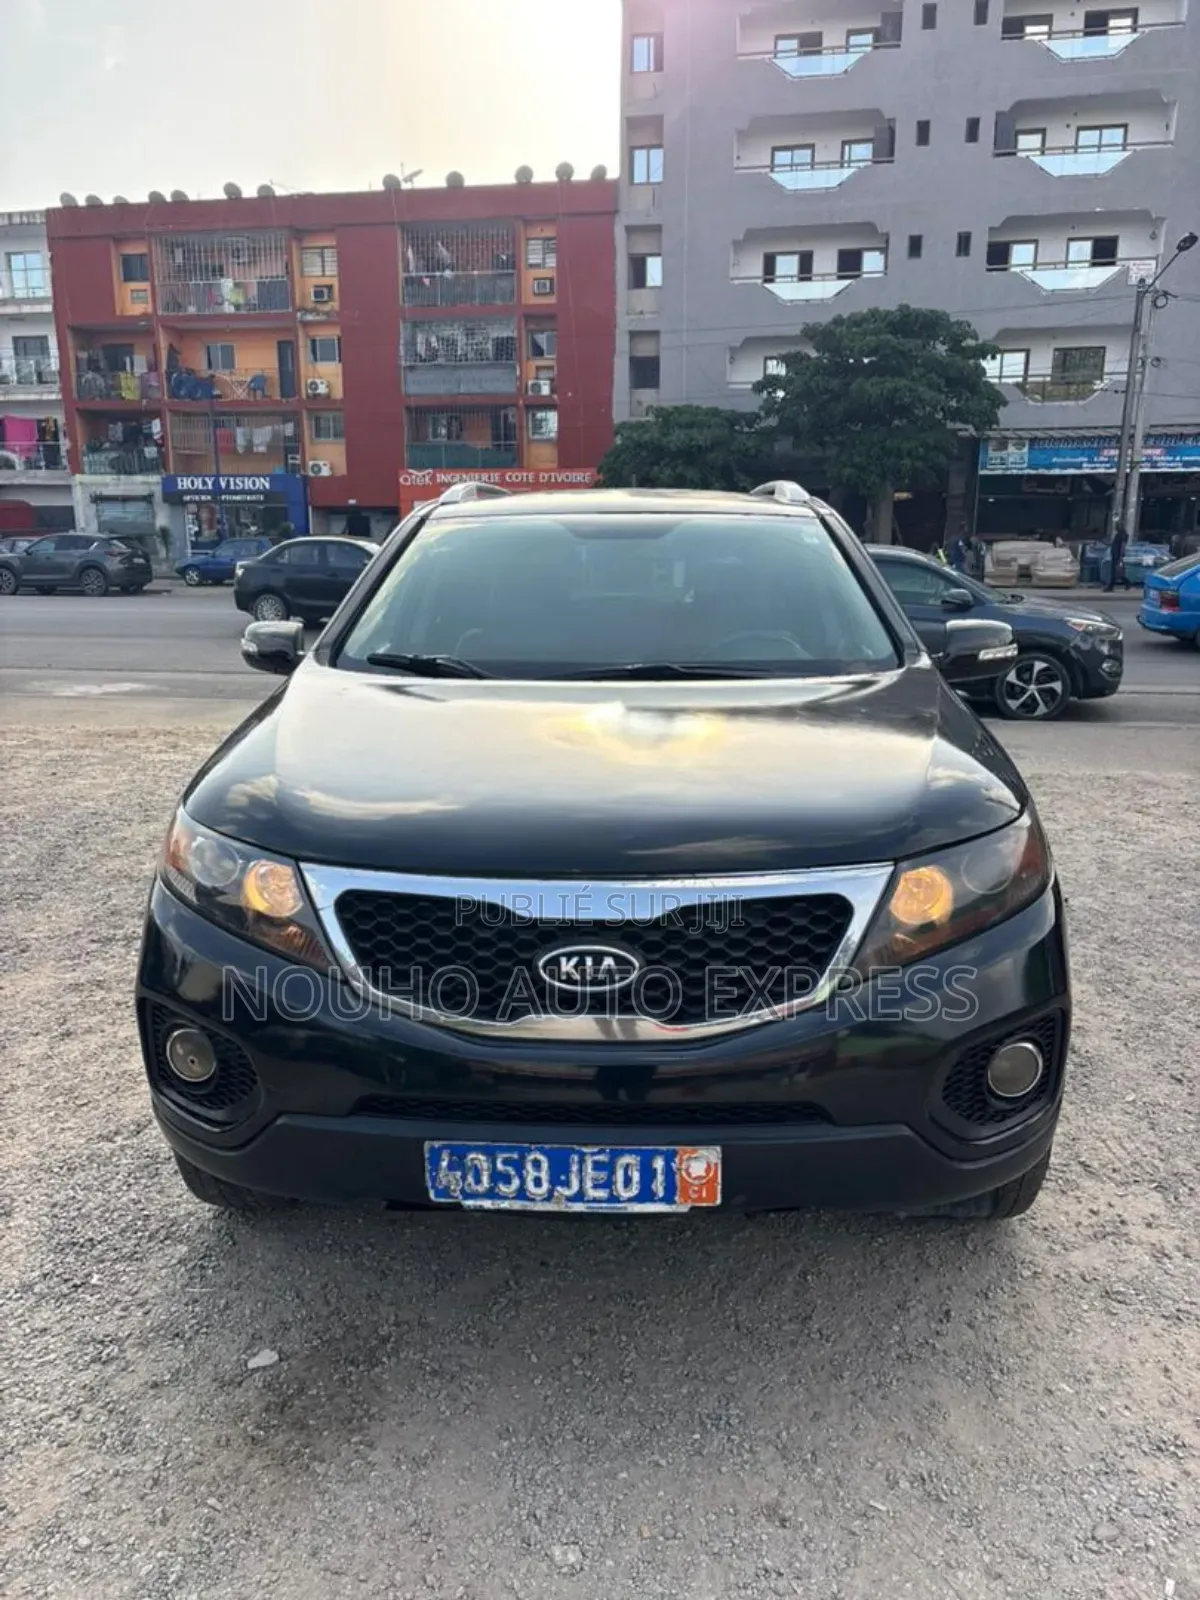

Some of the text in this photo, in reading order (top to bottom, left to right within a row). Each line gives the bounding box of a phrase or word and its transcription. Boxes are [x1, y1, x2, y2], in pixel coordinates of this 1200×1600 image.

[177, 476, 271, 490] HOLY VISION
[436, 473, 501, 484] INGENIERIE
[505, 473, 534, 484] COTE
[538, 472, 592, 484] D'IVOIRE
[559, 955, 619, 981] KIA
